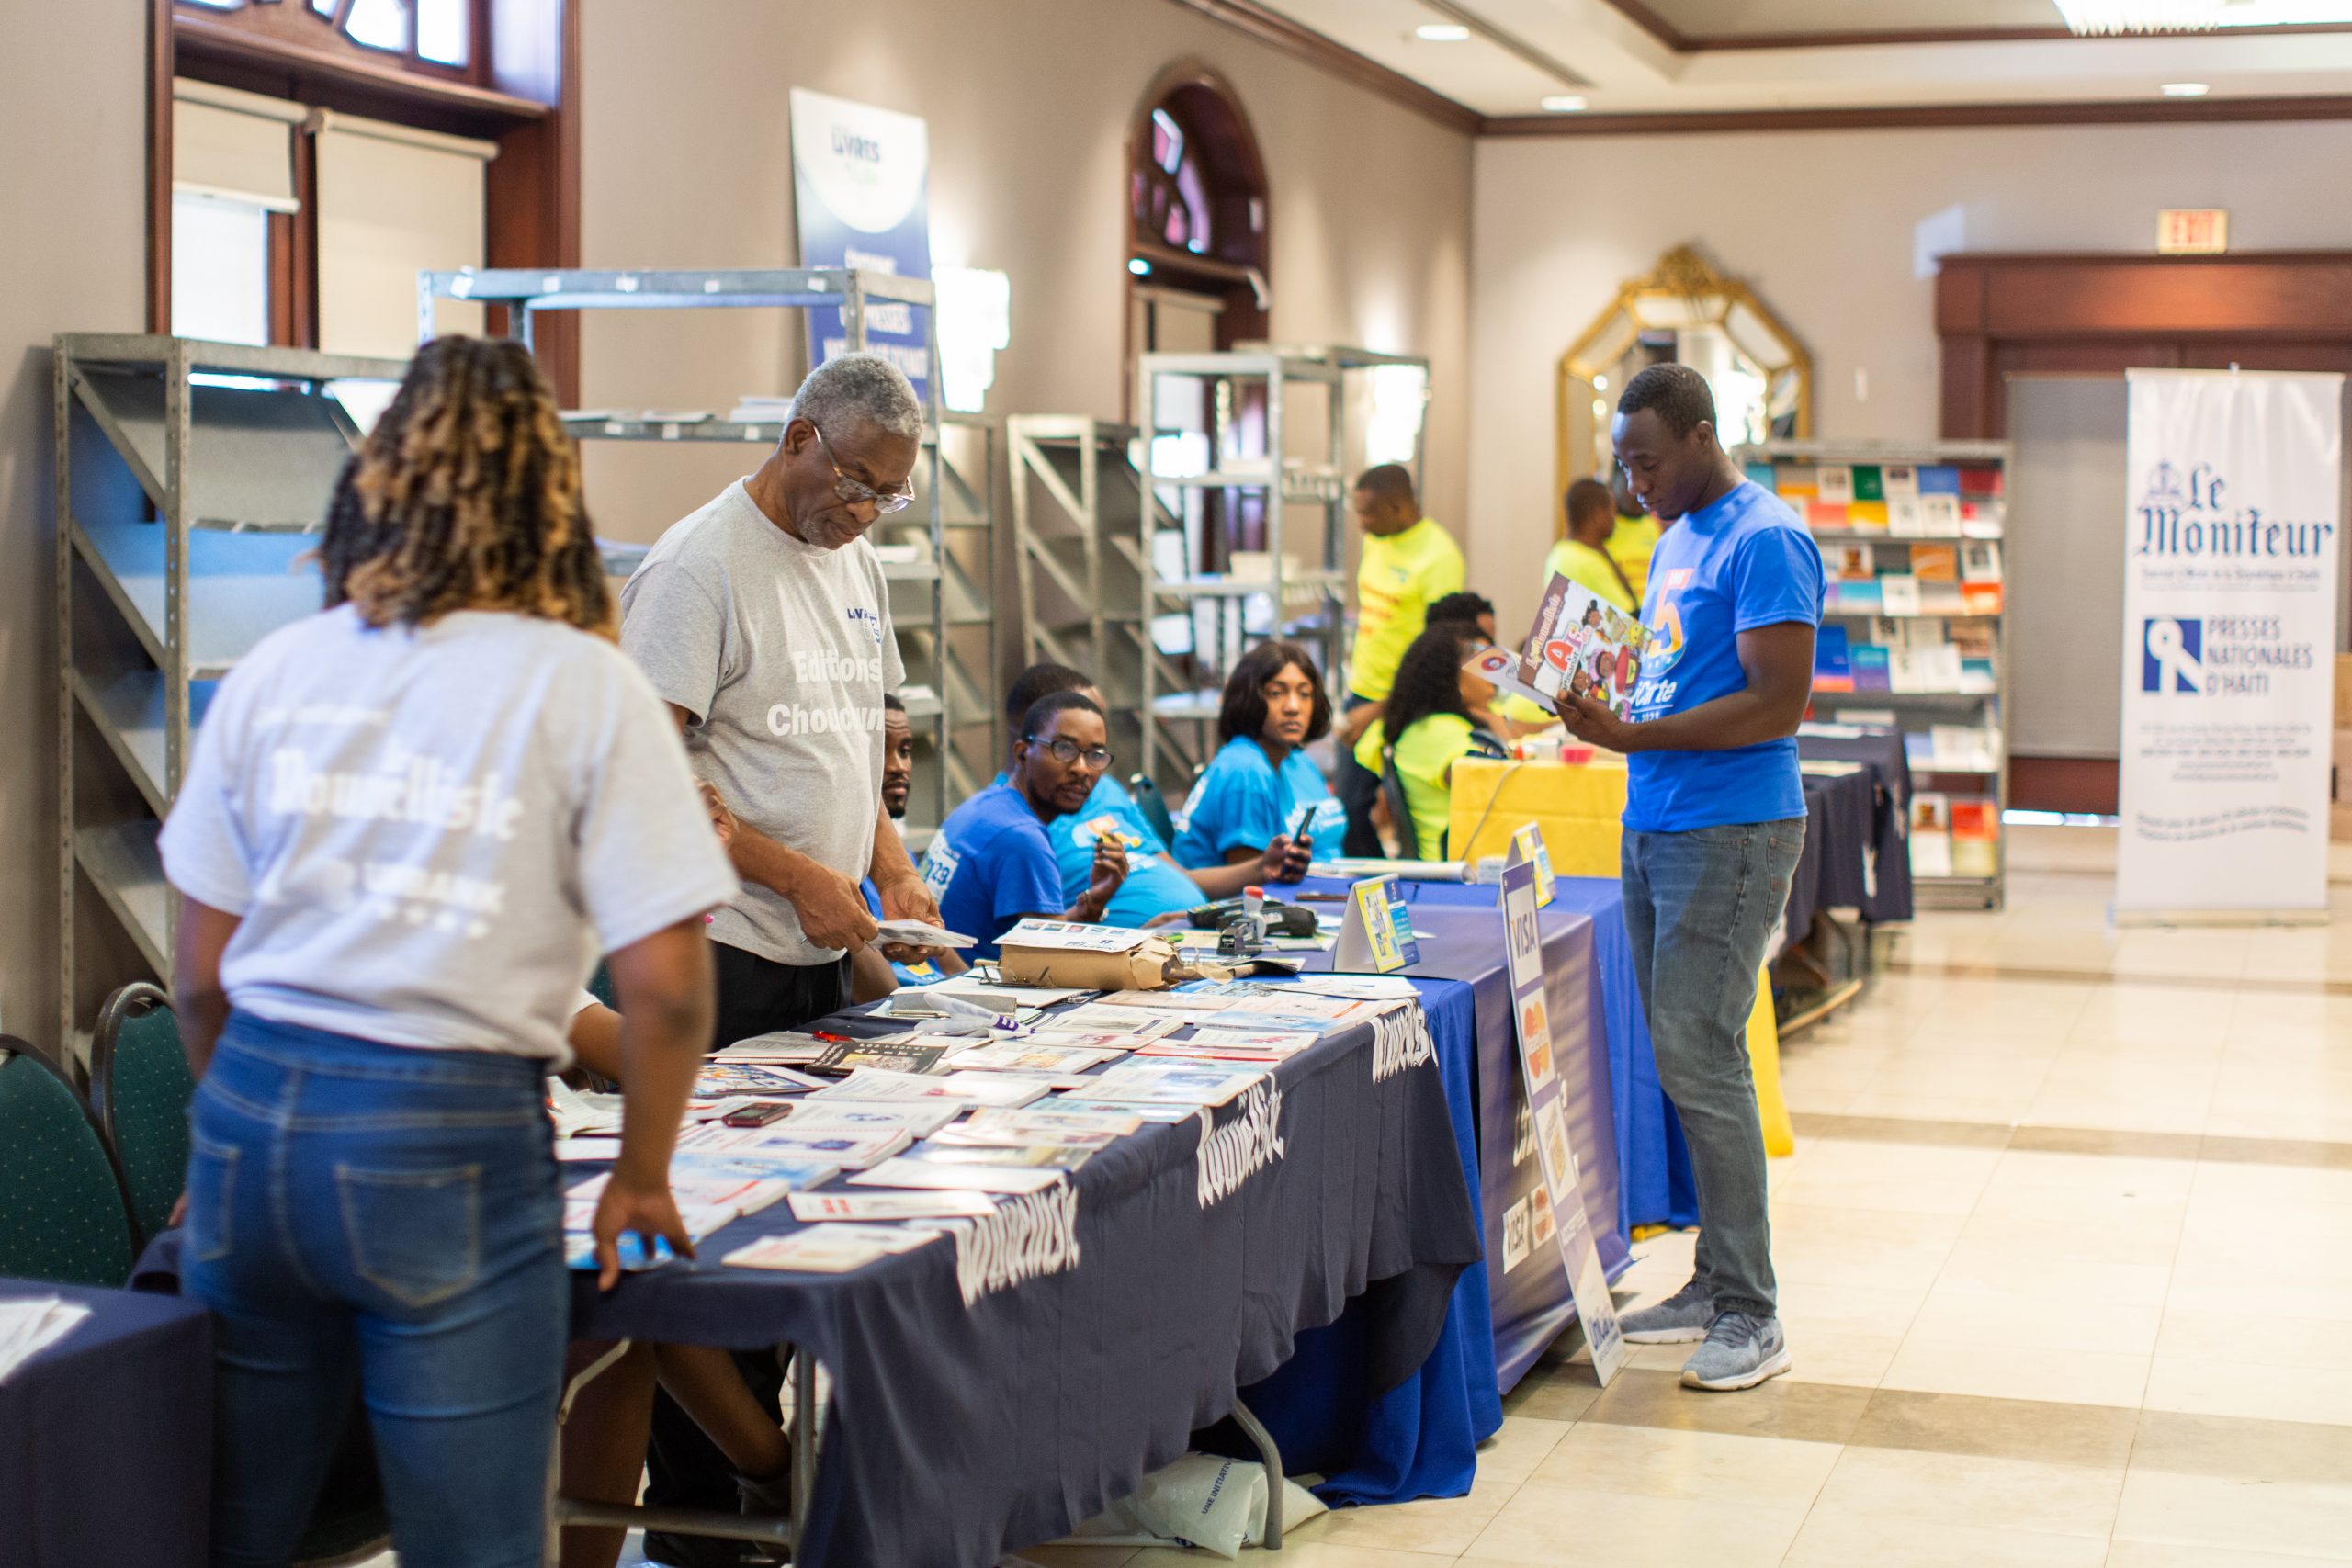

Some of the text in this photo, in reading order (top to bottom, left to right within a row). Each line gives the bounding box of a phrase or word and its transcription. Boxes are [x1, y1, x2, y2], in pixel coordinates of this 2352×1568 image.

[2187, 461, 2225, 511] Le
[2134, 506, 2333, 556] Moniteur
[2208, 616, 2280, 638] PRESSES
[2208, 645, 2312, 668] NATIONALES
[1511, 911, 1537, 960] VISA
[1201, 1459, 1233, 1515] UNE INITIATIV
